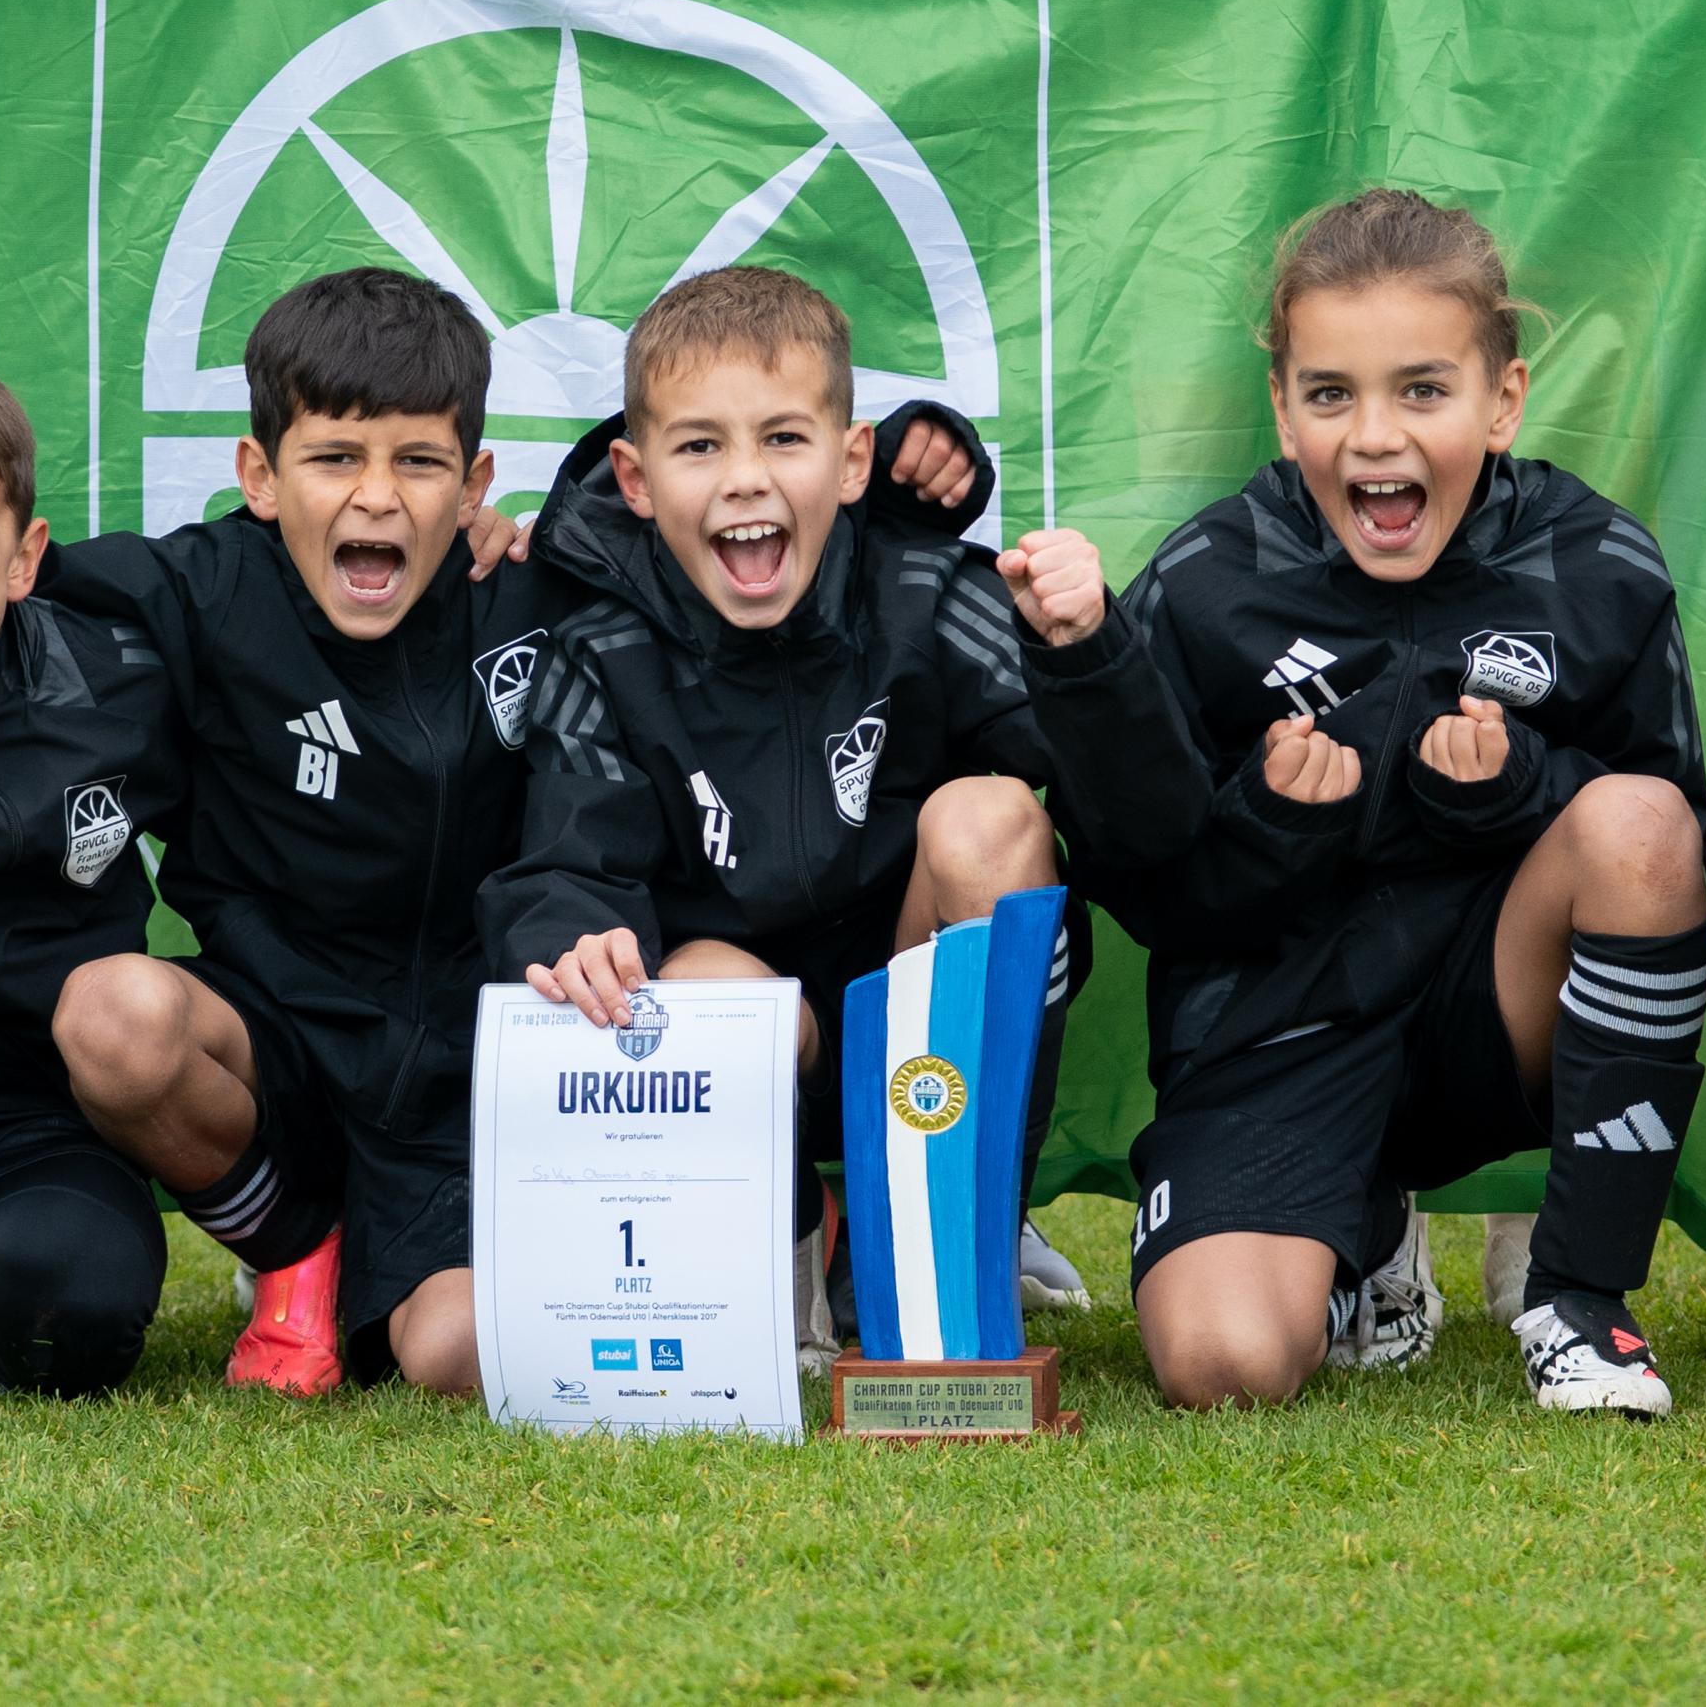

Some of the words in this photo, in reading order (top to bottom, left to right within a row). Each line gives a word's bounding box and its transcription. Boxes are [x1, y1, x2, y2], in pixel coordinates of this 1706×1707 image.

[1478, 663, 1521, 688] SPVGG.
[1525, 680, 1543, 694] 05
[1477, 679, 1528, 702] Frankfurt
[296, 742, 338, 800] BI
[75, 833, 111, 854] SPVGG.
[113, 827, 126, 841] 05
[76, 844, 119, 864] Frankfurt
[558, 1071, 711, 1114] URKUNDE
[605, 1132, 619, 1140] Wir
[620, 1132, 663, 1142] gratulieren
[619, 1194, 671, 1205] erfolgreichen
[619, 1220, 645, 1267] 1.
[615, 1277, 652, 1293] PLATZ
[544, 1302, 564, 1310] beim
[566, 1302, 605, 1310] Chairman
[607, 1302, 623, 1312] Cup
[625, 1302, 650, 1310] Stubai
[652, 1302, 729, 1311] Qualifikationturnier
[556, 1313, 576, 1321] Fürth
[578, 1313, 588, 1321] im
[590, 1313, 630, 1321] Odenwald
[632, 1313, 647, 1321] U10
[652, 1313, 698, 1321] Altersklasse
[700, 1313, 718, 1321] 2017
[597, 1349, 632, 1361] stubai
[653, 1358, 681, 1367] UNIQA
[618, 1389, 659, 1397] Raiffeisen
[690, 1389, 722, 1398] uhlsport
[854, 1384, 913, 1396] CHAIRMAN
[919, 1384, 941, 1396] CUP
[947, 1384, 987, 1396] STUBAI
[993, 1383, 1021, 1396] 2027
[853, 1399, 911, 1411] Qualifikation
[916, 1399, 941, 1411] Fürth
[945, 1399, 956, 1410] im
[960, 1399, 1003, 1411] Odenwald
[1008, 1399, 1024, 1411] U10
